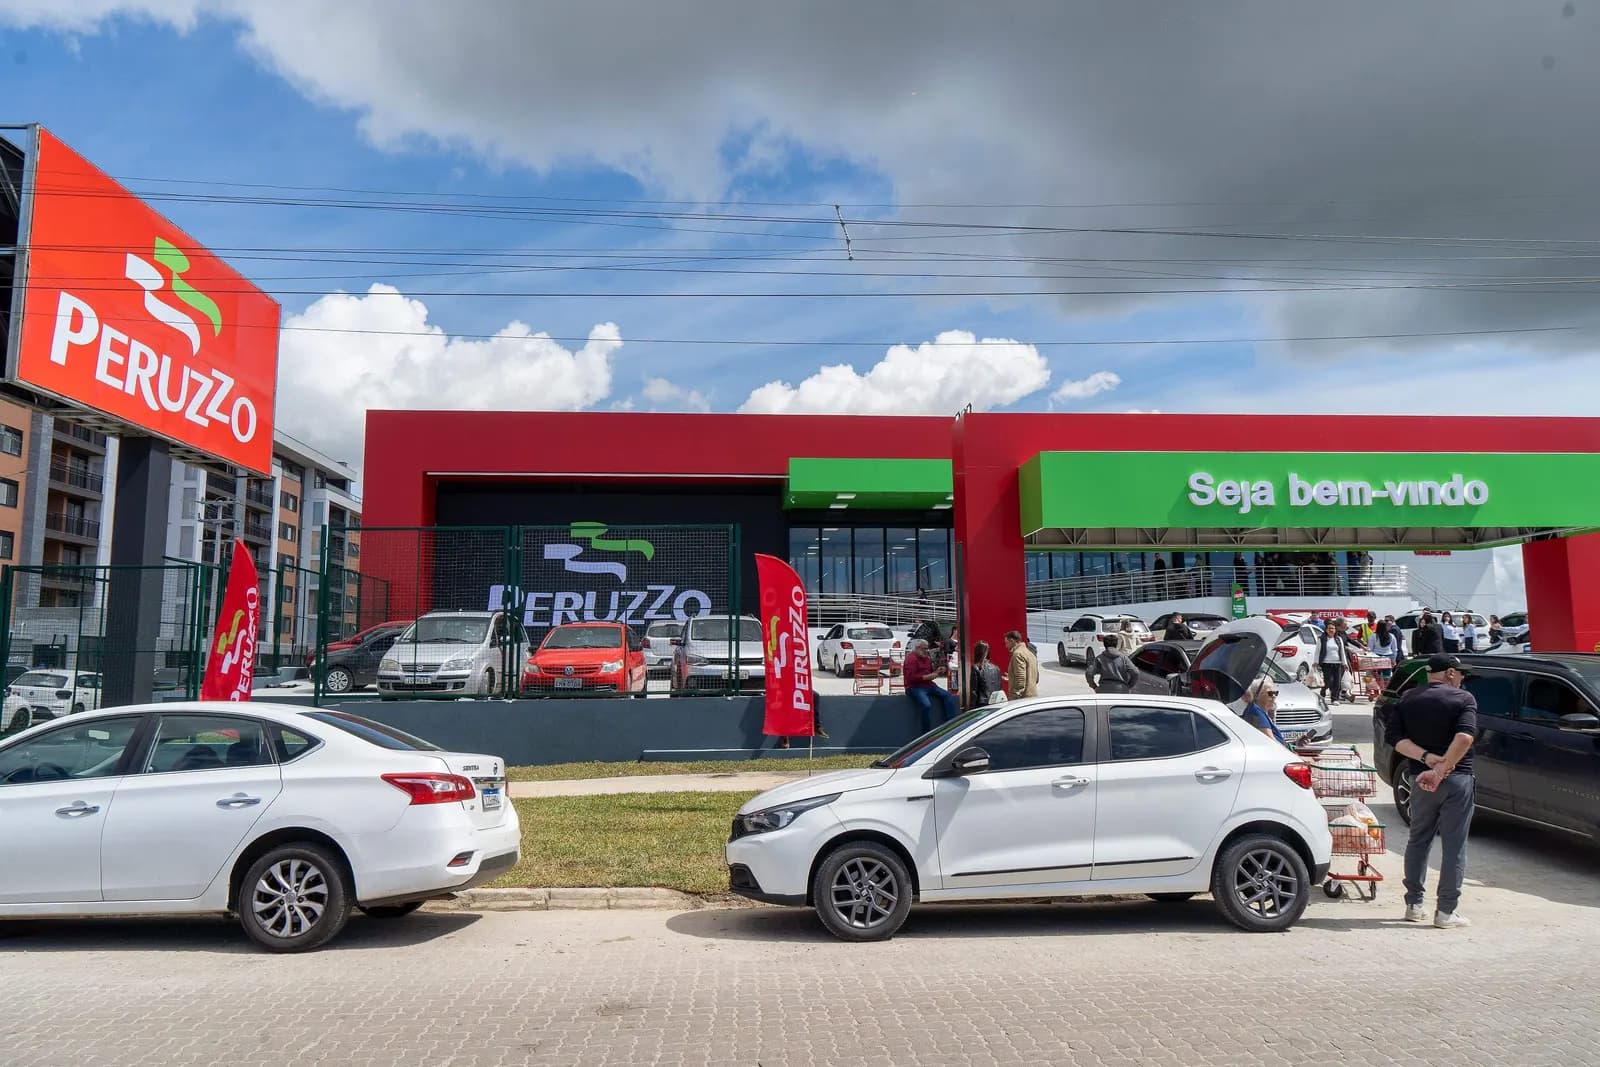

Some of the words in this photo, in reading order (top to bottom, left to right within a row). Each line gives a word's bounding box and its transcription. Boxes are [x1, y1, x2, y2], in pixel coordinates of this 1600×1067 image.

[50, 291, 257, 443] PERUZZO
[1188, 472, 1275, 514] Seja
[1288, 472, 1489, 507] bem-vindo
[488, 585, 712, 627] PERUZZO
[789, 586, 811, 711] PERUZZO
